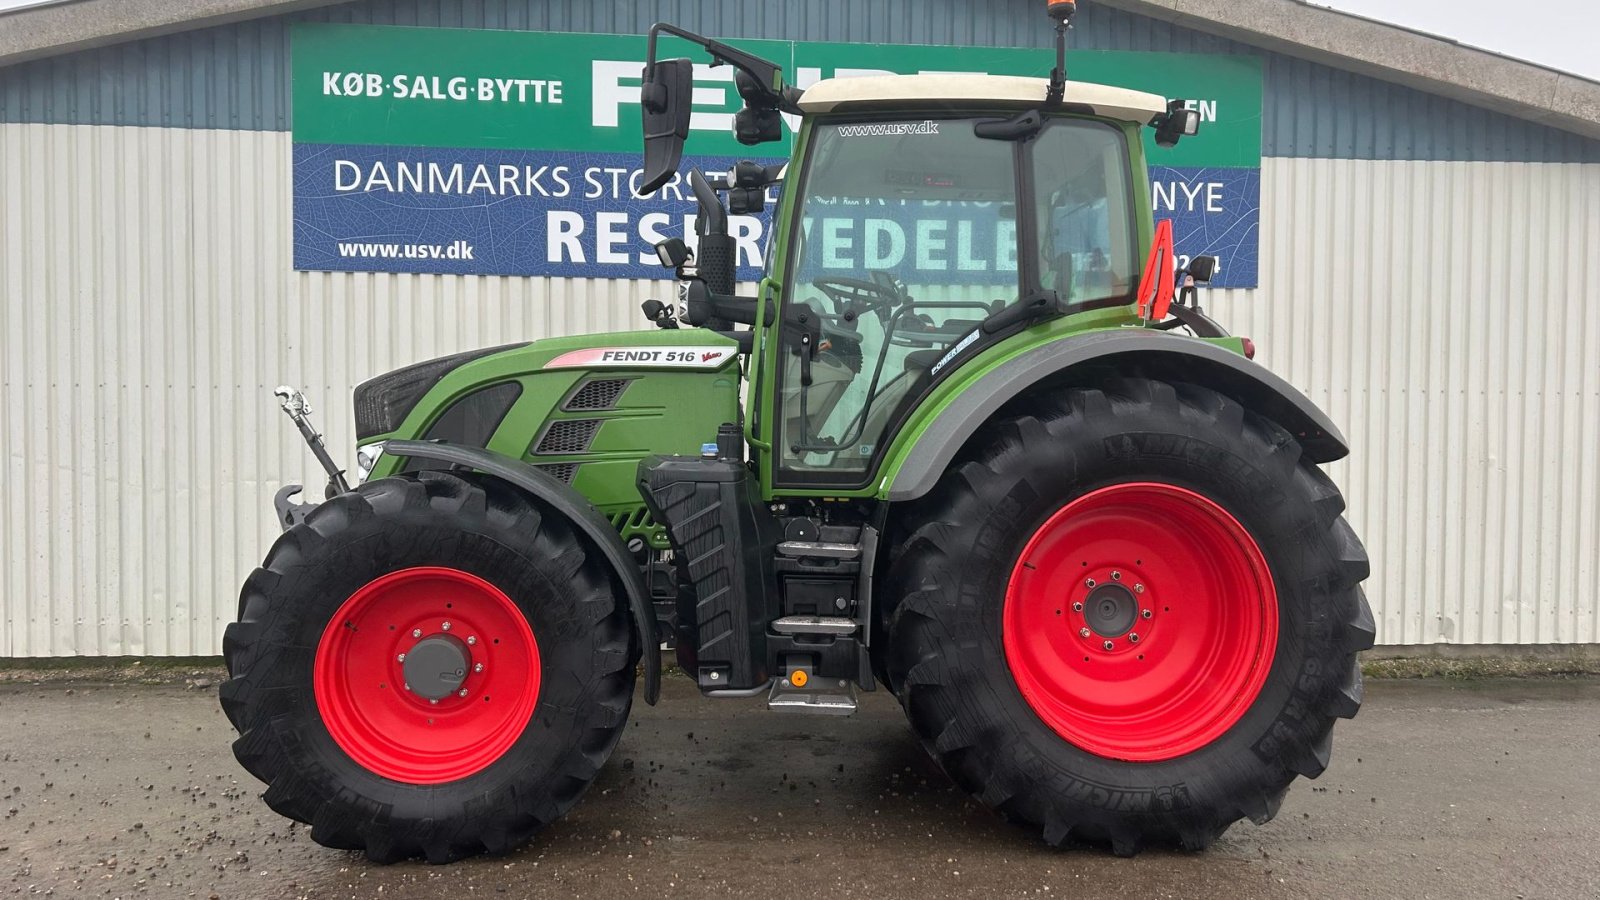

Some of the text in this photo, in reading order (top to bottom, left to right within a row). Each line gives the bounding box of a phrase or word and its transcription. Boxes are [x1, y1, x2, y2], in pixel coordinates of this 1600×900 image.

[838, 121, 939, 136] www.usv.dk
[335, 160, 571, 198] DANMARKS
[585, 167, 728, 201] STØRST
[1152, 181, 1224, 212] NYE
[338, 240, 473, 260] www.usv.dk
[602, 351, 661, 362] FENDT
[665, 352, 695, 362] 516
[1014, 744, 1152, 812] MICHE
